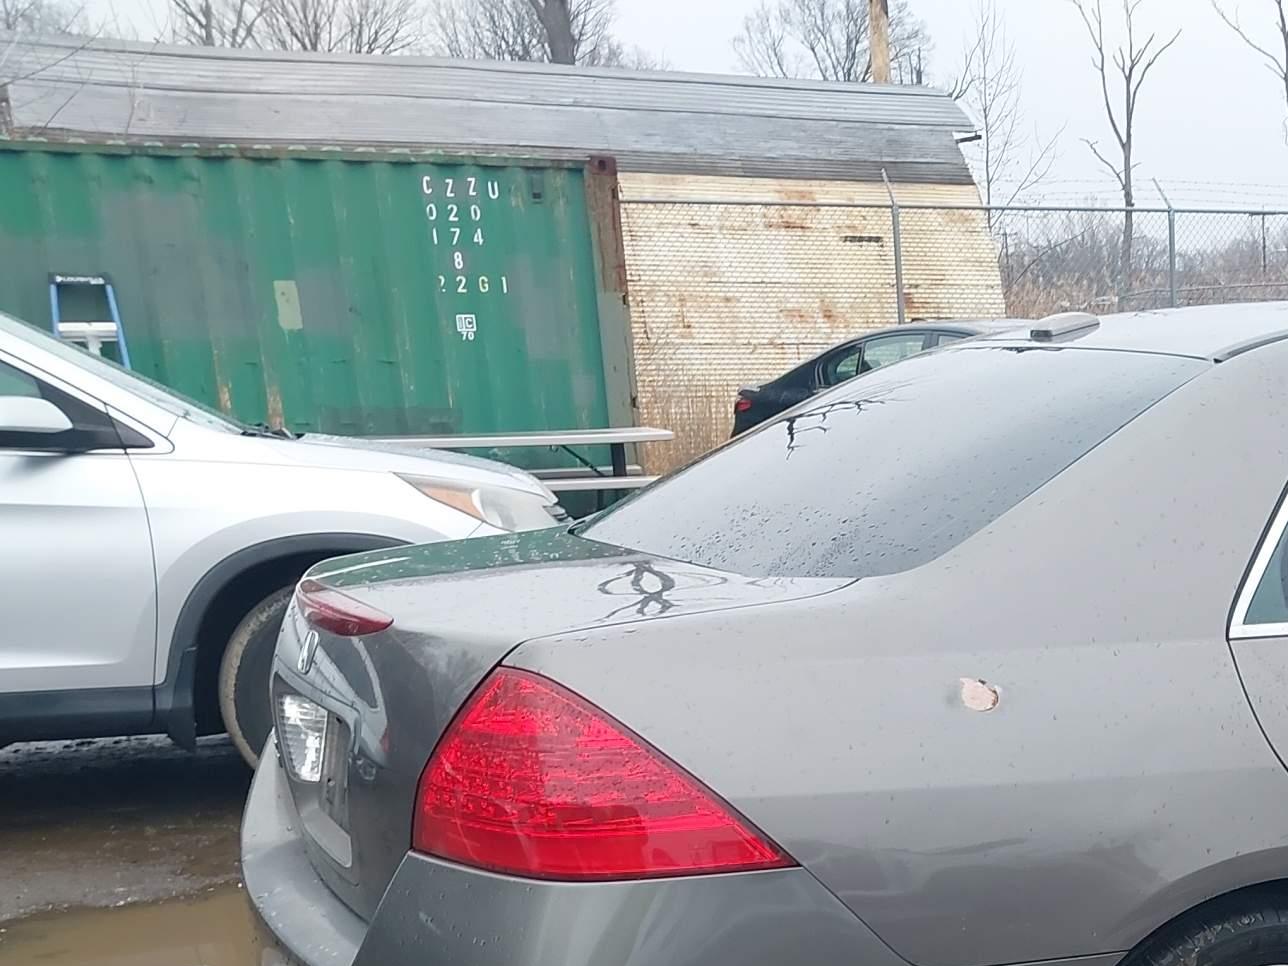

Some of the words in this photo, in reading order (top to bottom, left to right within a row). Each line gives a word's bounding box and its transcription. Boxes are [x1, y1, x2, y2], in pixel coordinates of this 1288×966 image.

[422, 176, 499, 199] CZZU
[426, 203, 481, 221] 020
[432, 228, 484, 245] 174
[453, 252, 463, 269] 8
[461, 332, 475, 341] 70
